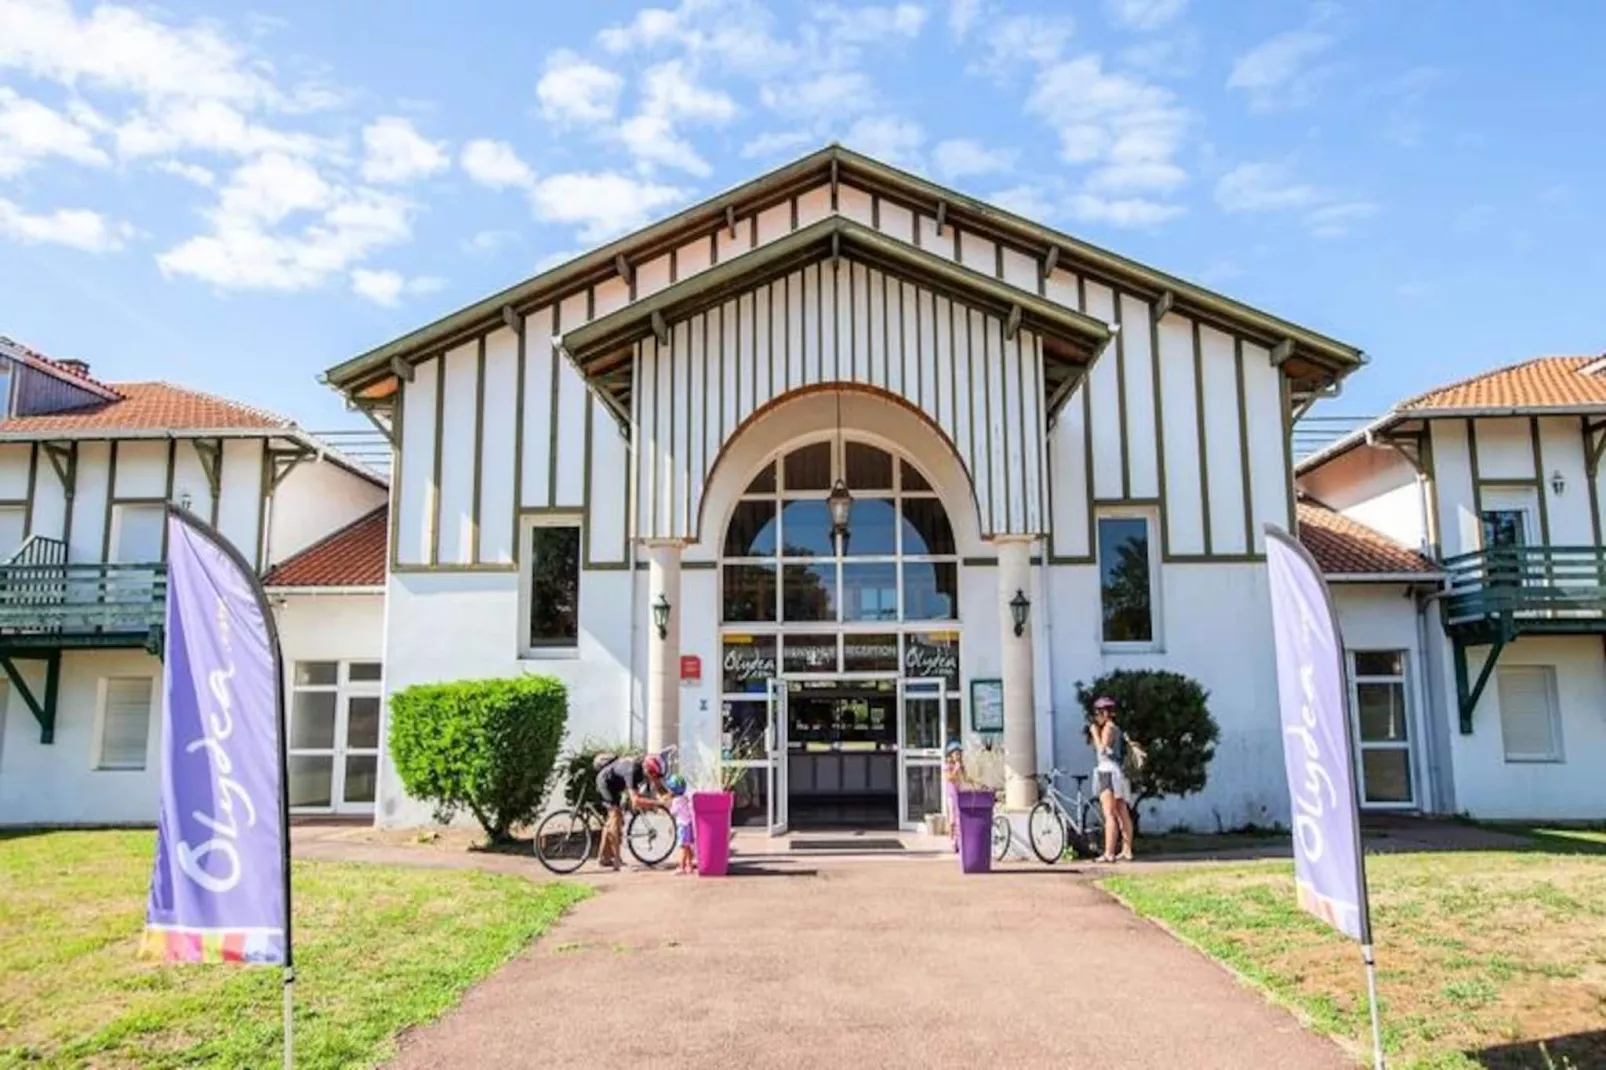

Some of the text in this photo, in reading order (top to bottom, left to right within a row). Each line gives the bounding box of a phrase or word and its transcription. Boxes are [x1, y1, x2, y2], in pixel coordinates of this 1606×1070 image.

[724, 648, 775, 681] Olydea
[906, 646, 957, 676] Olydea
[177, 661, 256, 893] Olydea
[1287, 663, 1337, 863] Olydea
